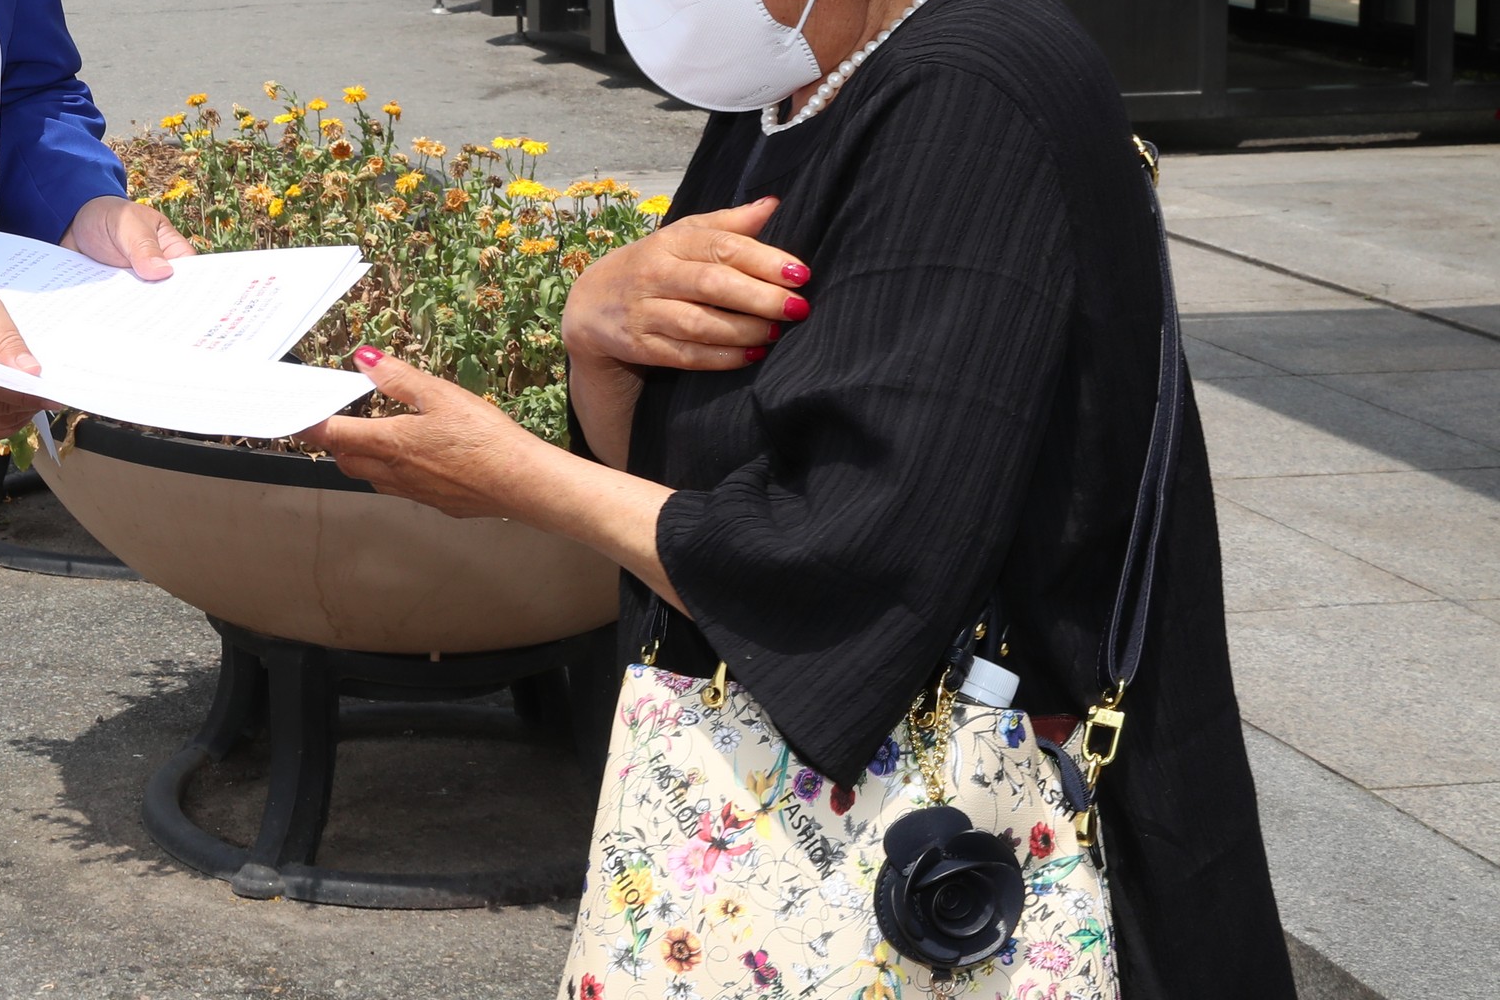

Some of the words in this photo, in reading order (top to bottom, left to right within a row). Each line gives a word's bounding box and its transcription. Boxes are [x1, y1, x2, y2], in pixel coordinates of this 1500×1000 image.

[649, 753, 701, 839] FASHION
[779, 790, 837, 881] FASHION
[599, 832, 650, 923] FASHION
